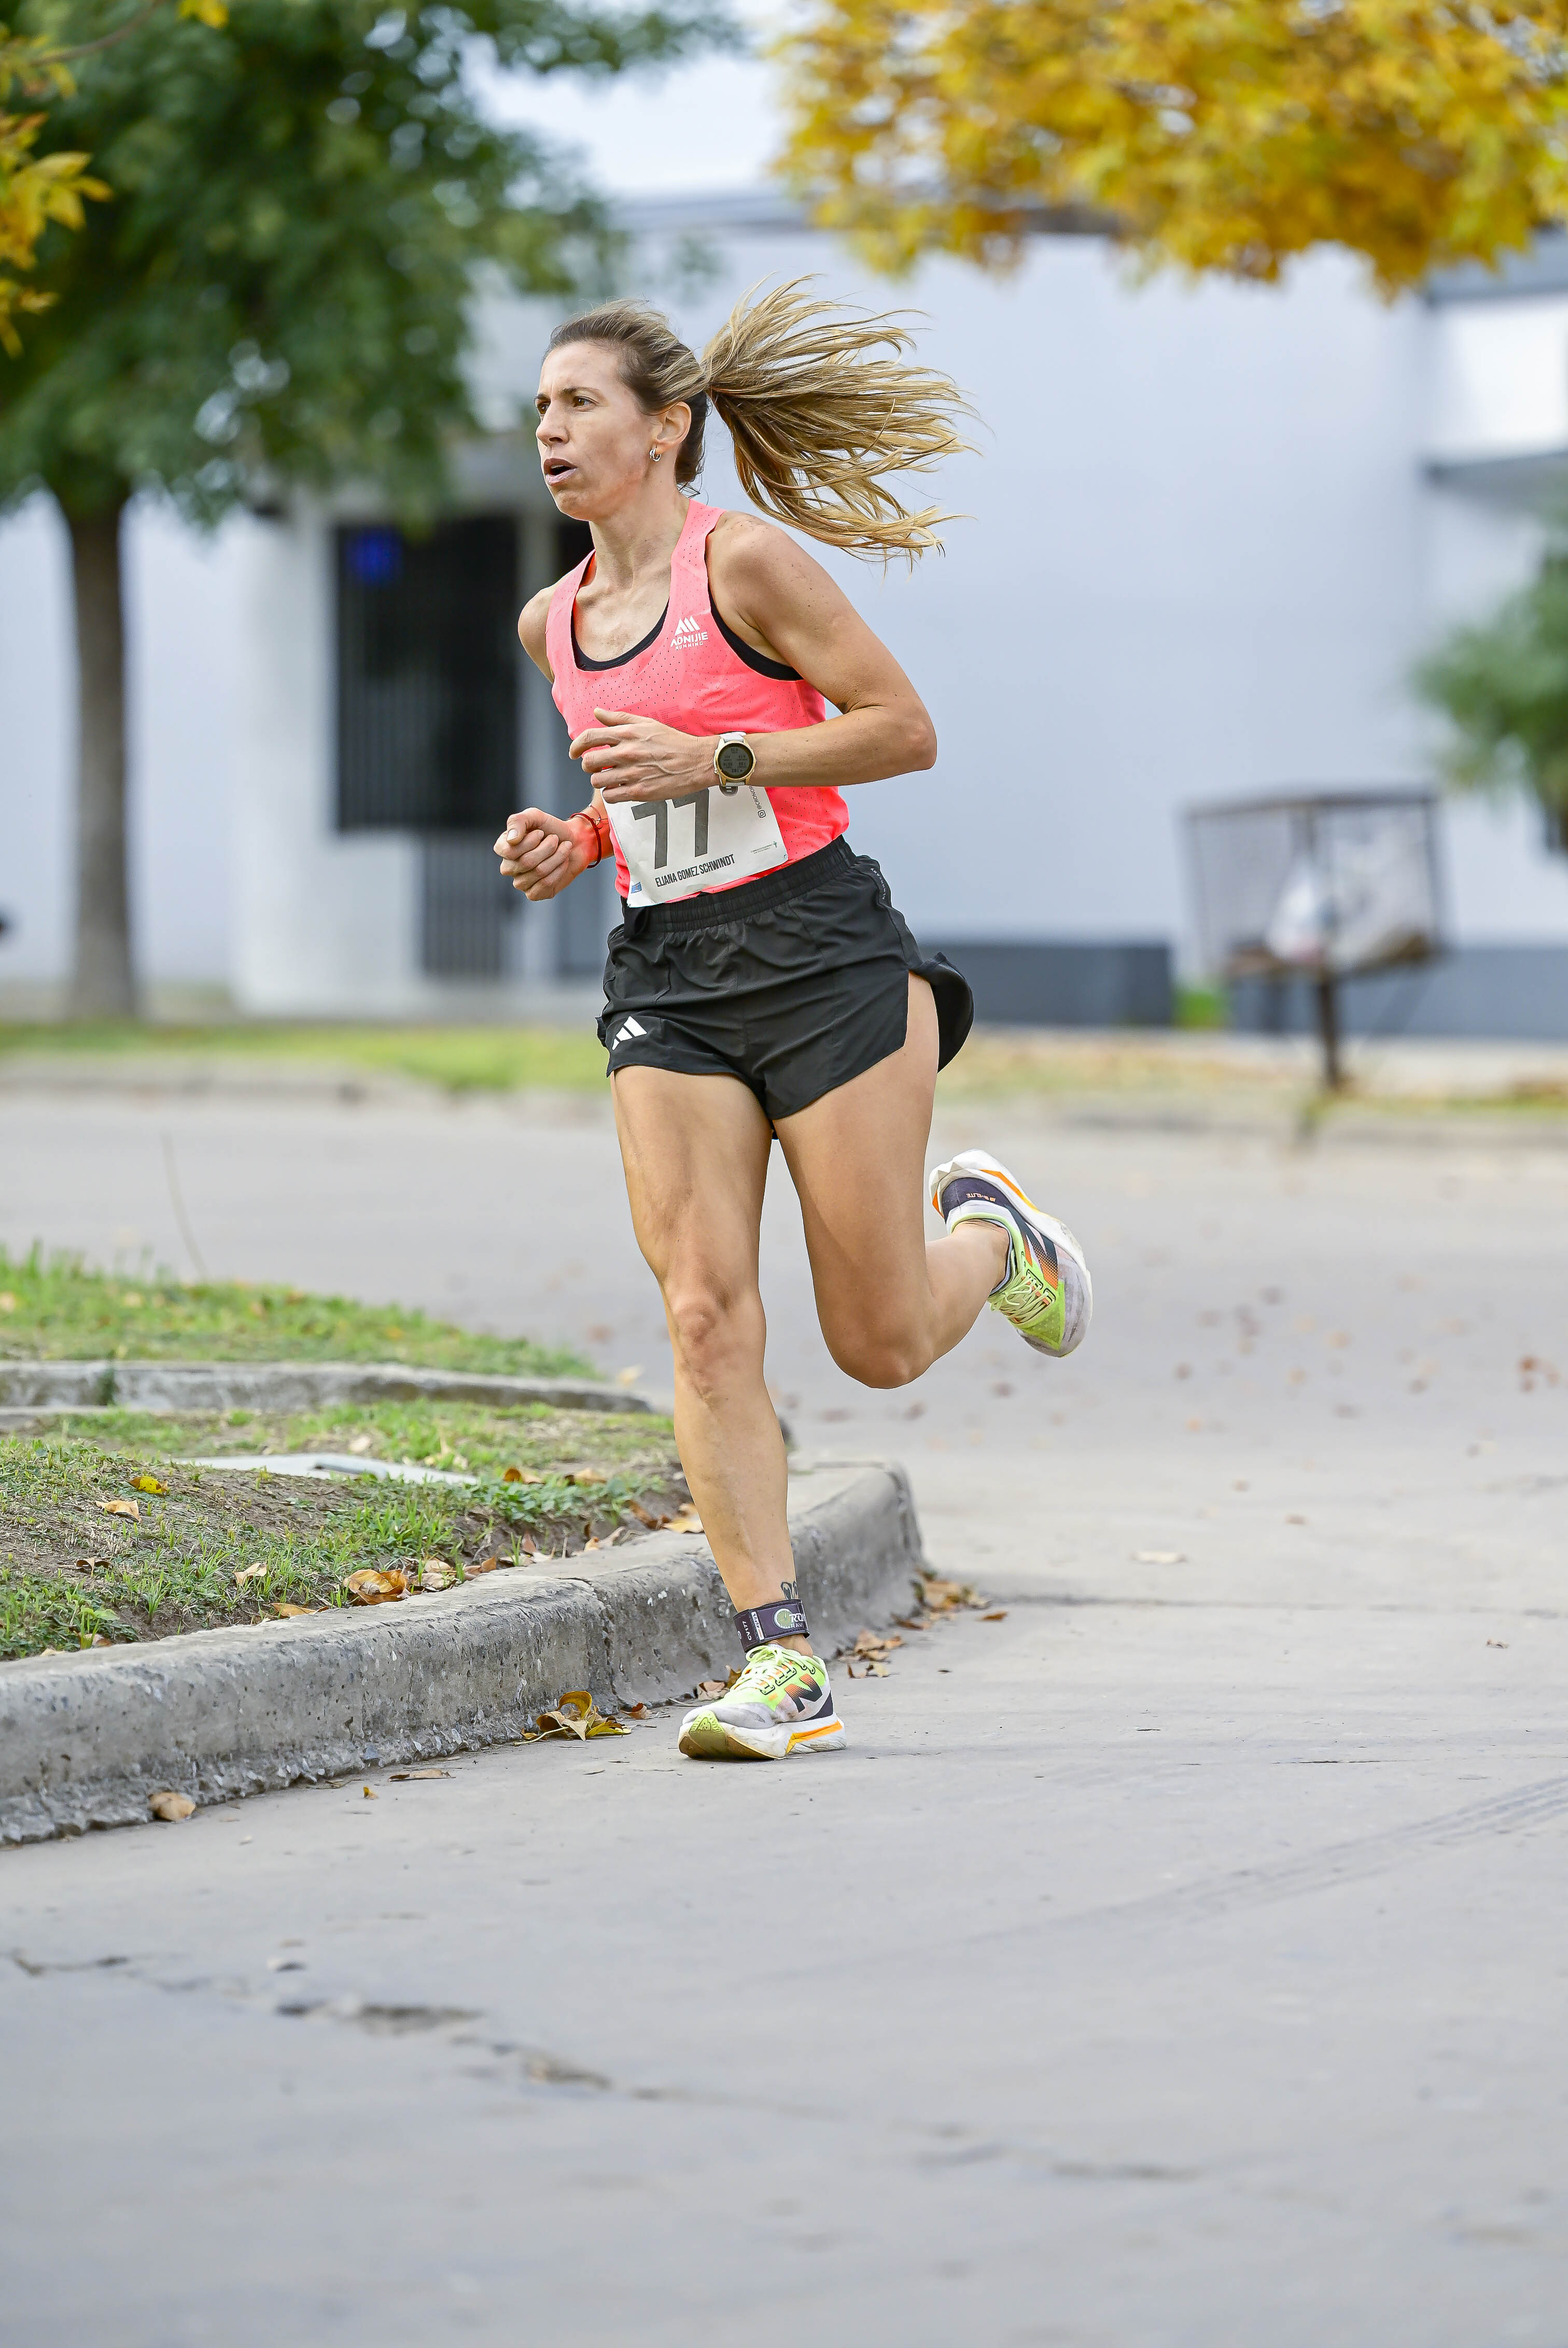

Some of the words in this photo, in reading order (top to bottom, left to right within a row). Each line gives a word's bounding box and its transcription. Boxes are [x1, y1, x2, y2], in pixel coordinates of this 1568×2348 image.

[675, 641, 703, 650] RUNNING
[631, 788, 709, 870] 77
[655, 873, 678, 887] ELIANA
[677, 866, 699, 880] GOMEZ
[698, 854, 735, 874] SCHWINDT
[742, 1621, 752, 1641] CV177
